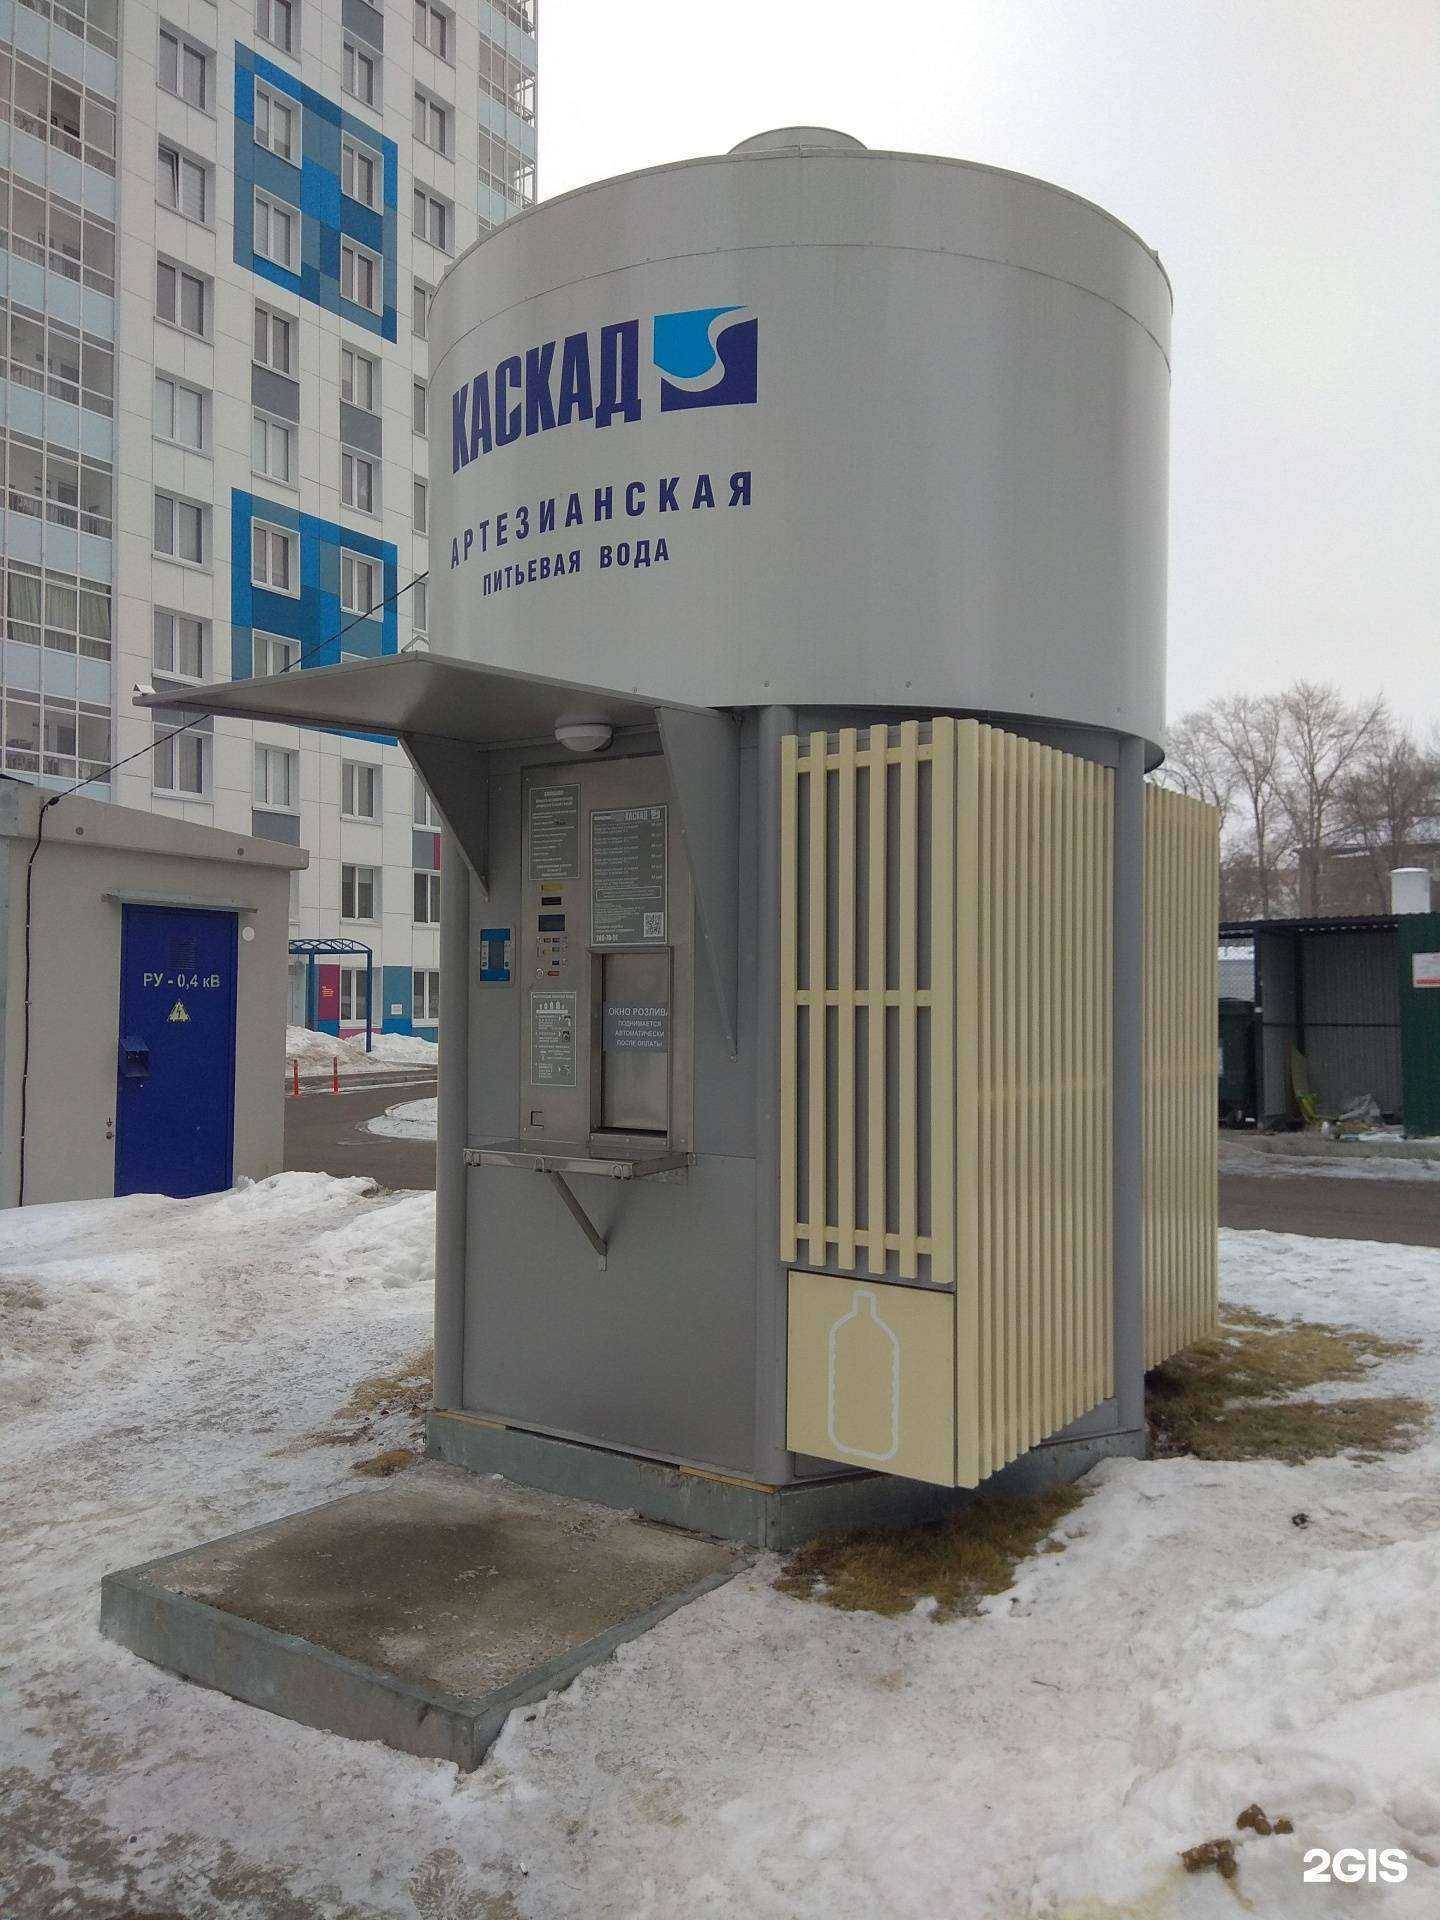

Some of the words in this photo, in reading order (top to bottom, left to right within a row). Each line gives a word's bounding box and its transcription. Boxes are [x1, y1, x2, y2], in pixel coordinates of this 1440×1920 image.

[452, 319, 642, 475] КАСКАД
[450, 471, 752, 570] АРТЕЗИАНСКАЯ
[482, 549, 582, 597] ПИТЬЕВАЯ
[599, 537, 670, 569] ВОДА
[143, 972, 164, 987] РУ
[177, 973, 199, 990] 0,4
[202, 974, 220, 988] кВ
[608, 1007, 631, 1016] ОКНО
[617, 1020, 662, 1028] ПОДНИМАЕТСЯ
[615, 1030, 665, 1038] АВТОМАТИЧЕСКИ
